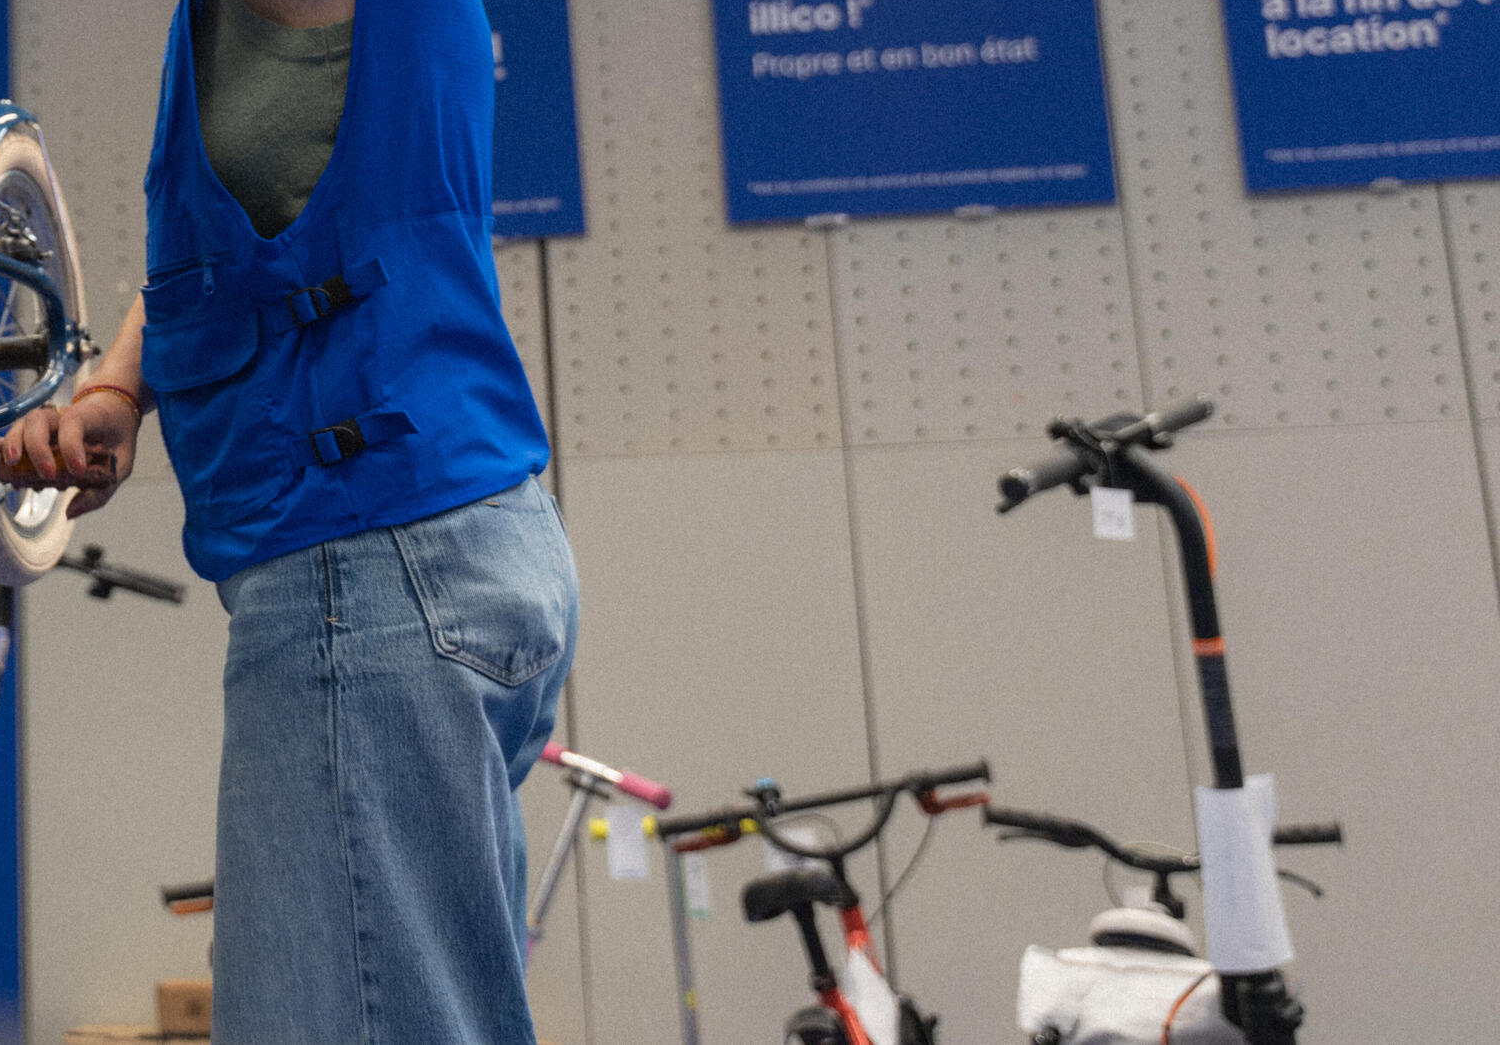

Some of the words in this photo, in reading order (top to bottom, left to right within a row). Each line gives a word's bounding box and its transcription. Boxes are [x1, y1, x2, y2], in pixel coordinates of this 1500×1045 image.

[752, 51, 845, 81] Propre
[847, 47, 879, 74] et
[881, 47, 919, 72] en
[921, 42, 979, 69] bon
[980, 35, 1041, 65] état
